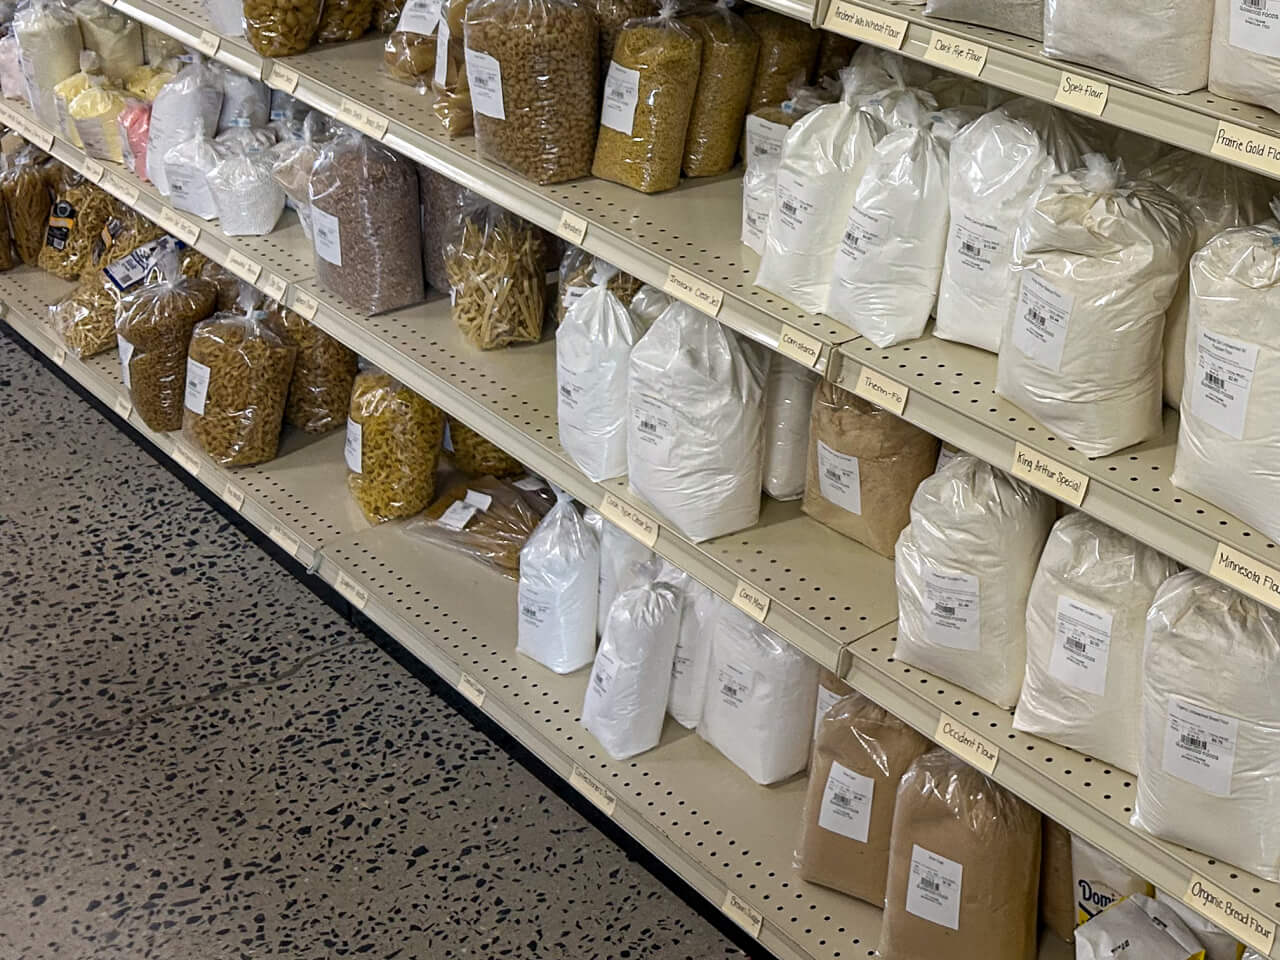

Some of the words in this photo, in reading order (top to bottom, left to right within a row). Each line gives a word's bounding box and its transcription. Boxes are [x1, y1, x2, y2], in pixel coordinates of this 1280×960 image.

[965, 48, 983, 63] Flour
[1062, 77, 1082, 98] Spelt
[1083, 84, 1104, 102] Flour
[1216, 127, 1243, 153] Prairie
[1245, 137, 1266, 157] Gold
[1017, 451, 1033, 473] King
[1034, 459, 1056, 479] Arthur
[1057, 471, 1082, 493] Special
[1219, 551, 1264, 585] Minnesota
[942, 722, 976, 748] Occident
[976, 742, 996, 761] Flour
[1078, 879, 1117, 908] Domi
[1191, 881, 1224, 909] Organic
[1225, 899, 1249, 925] Bread
[1250, 916, 1272, 940] Flour
